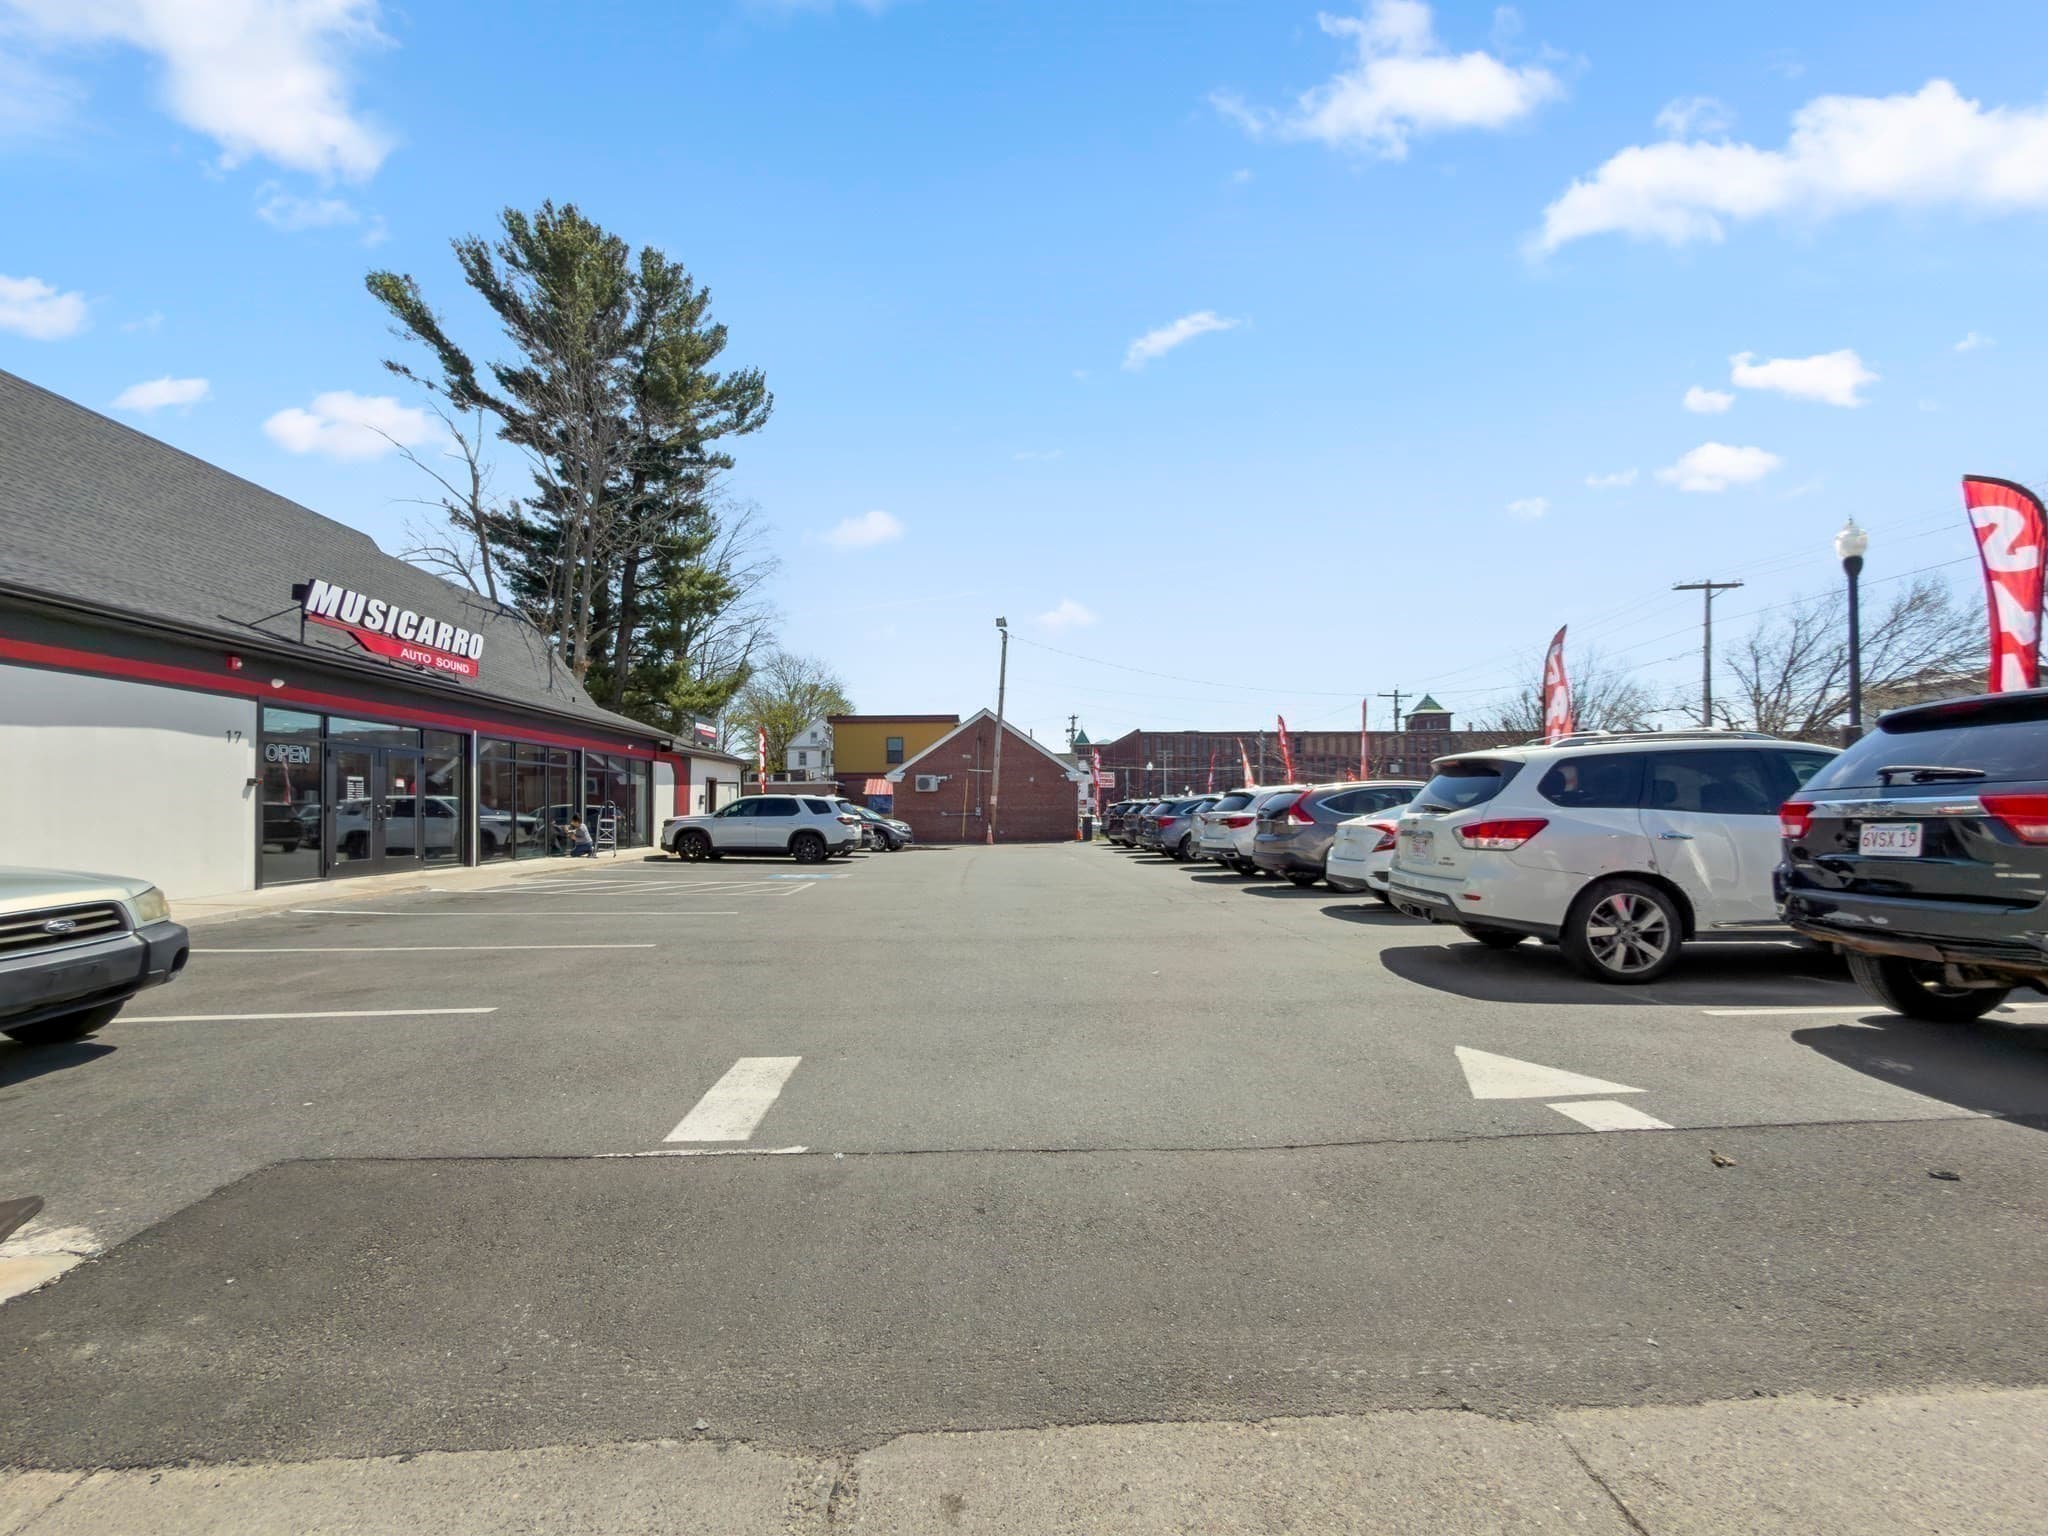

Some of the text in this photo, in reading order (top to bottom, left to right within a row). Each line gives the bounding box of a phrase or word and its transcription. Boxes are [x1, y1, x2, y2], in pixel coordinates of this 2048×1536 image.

[306, 579, 484, 660] MUSICARRO
[401, 648, 469, 673] AUTO SOUND
[226, 730, 242, 744] 17
[265, 743, 310, 764] OPEN
